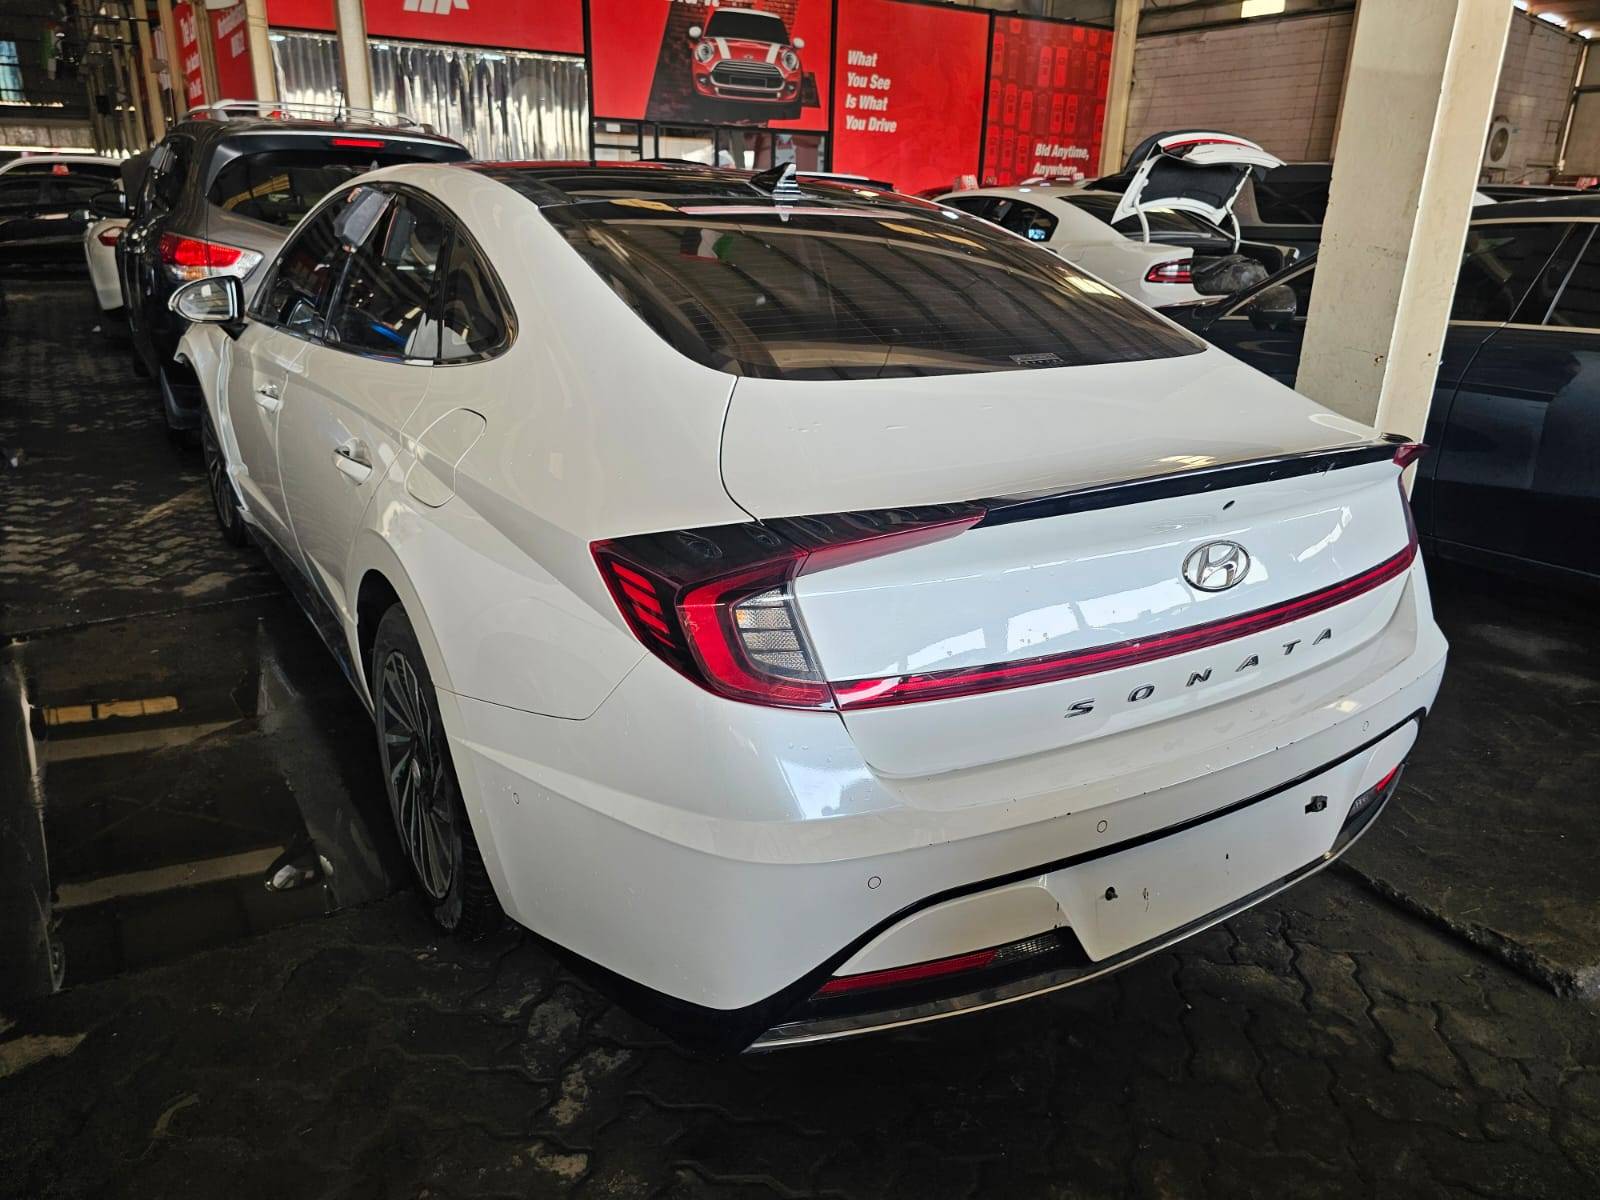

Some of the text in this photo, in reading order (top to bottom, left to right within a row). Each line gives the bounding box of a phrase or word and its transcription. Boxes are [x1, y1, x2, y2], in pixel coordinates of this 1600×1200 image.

[848, 50, 877, 67] What
[847, 72, 891, 90] You See
[845, 94, 888, 111] Is What
[846, 115, 897, 132] You Drive
[1035, 143, 1089, 160] Bid Anytime,
[1065, 628, 1332, 718] SONATA
